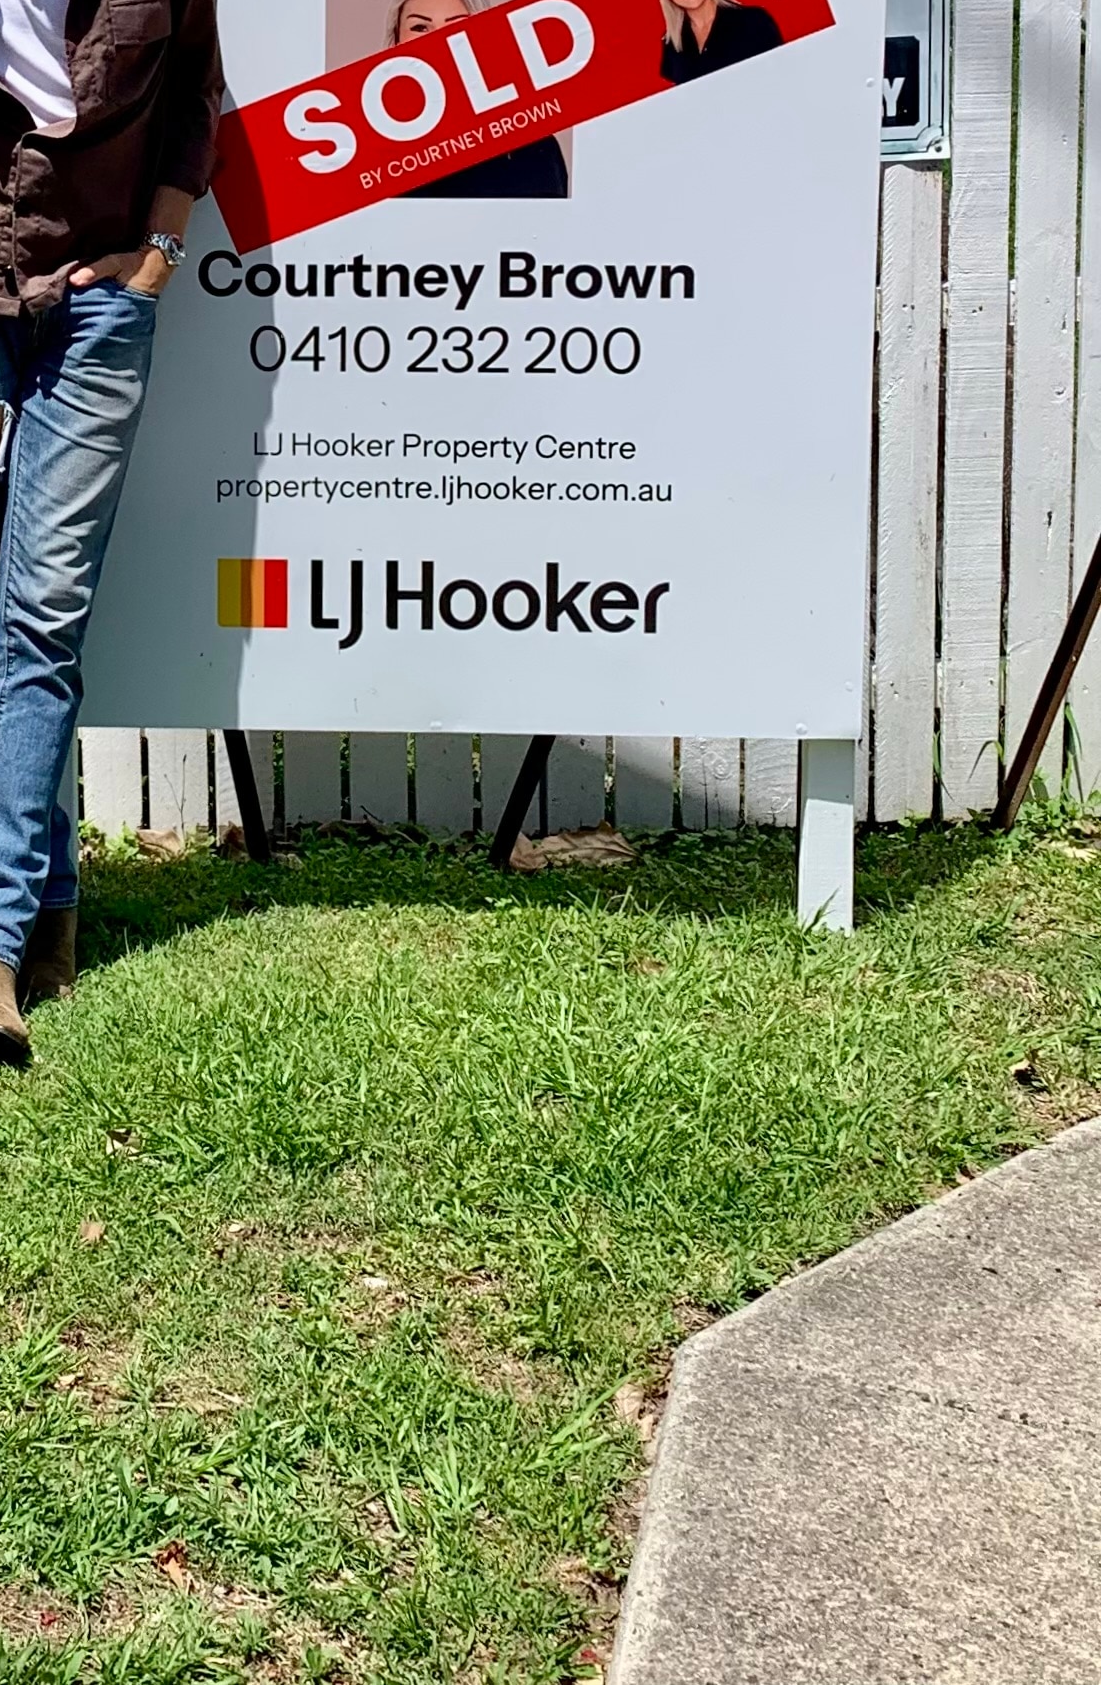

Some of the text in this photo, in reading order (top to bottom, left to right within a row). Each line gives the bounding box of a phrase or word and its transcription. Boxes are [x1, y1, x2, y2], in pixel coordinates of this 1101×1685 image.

[359, 98, 563, 189] BY COURTNEY BROWN
[198, 249, 695, 311] Courtney Brown
[249, 325, 641, 375] 0410 232 200
[253, 431, 637, 465] LJ Hooker Property Centre
[216, 475, 673, 506] propertycentre.ljhooker.com.au
[311, 559, 670, 650] LJ Hooker
